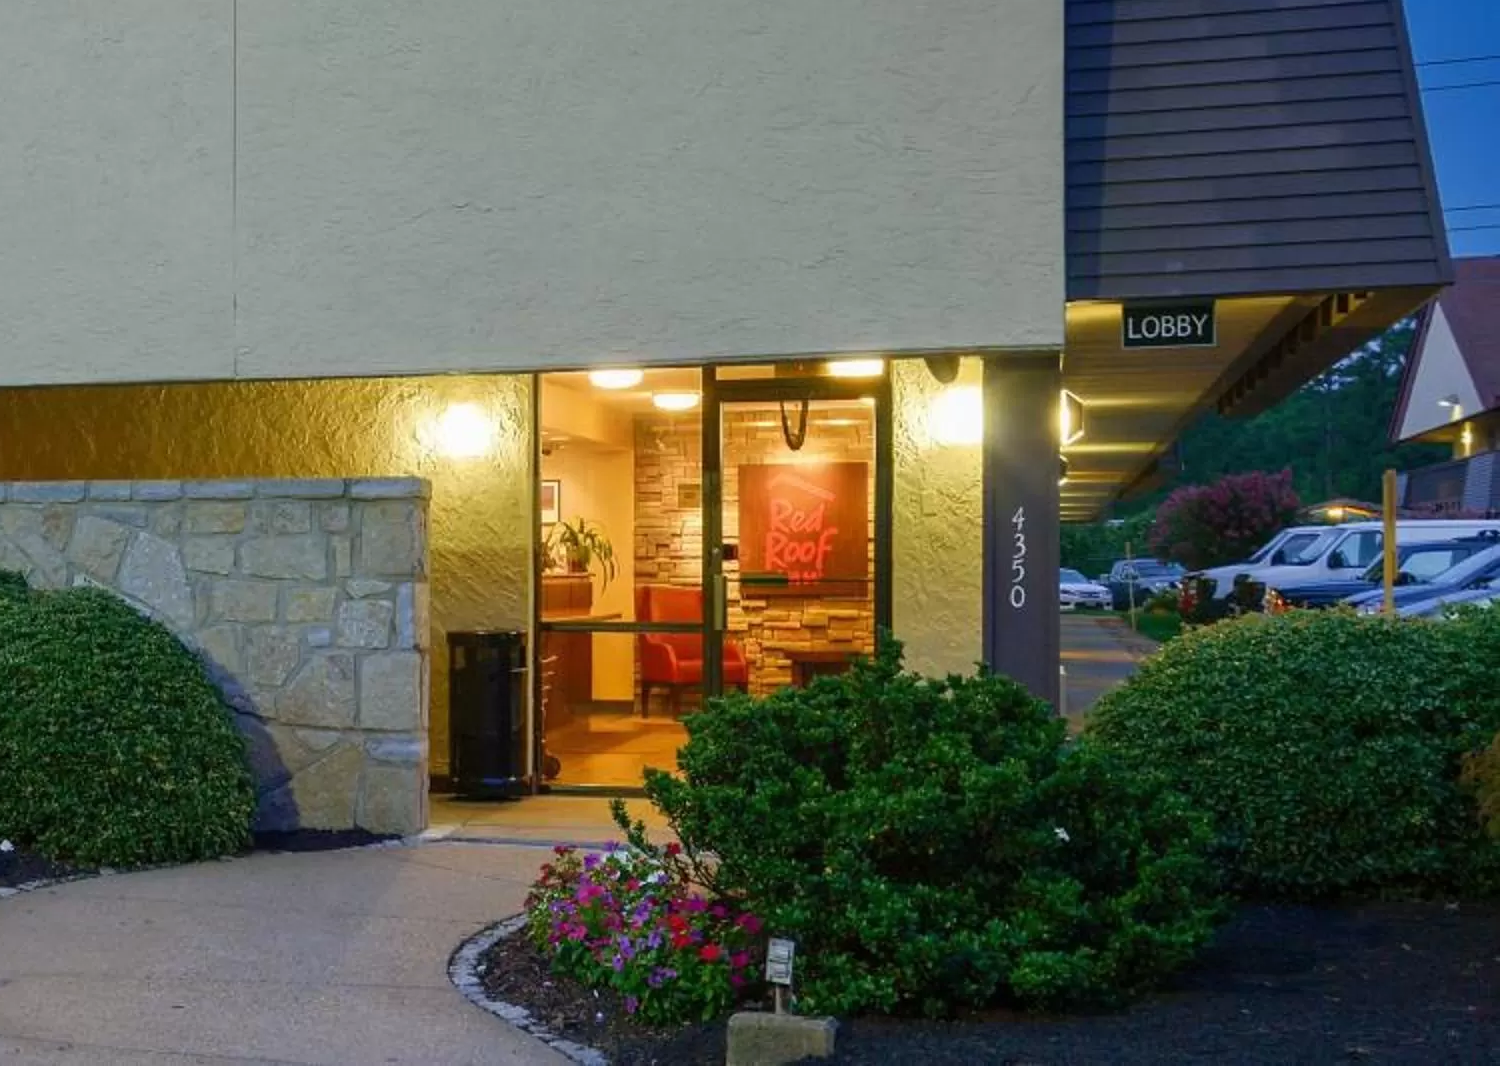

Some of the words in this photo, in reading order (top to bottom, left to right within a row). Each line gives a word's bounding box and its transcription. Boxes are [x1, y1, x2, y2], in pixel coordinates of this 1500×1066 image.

[1127, 313, 1209, 339] LOBBY
[770, 498, 826, 534] Red
[765, 526, 838, 577] Roof
[1010, 506, 1027, 608] 4350
